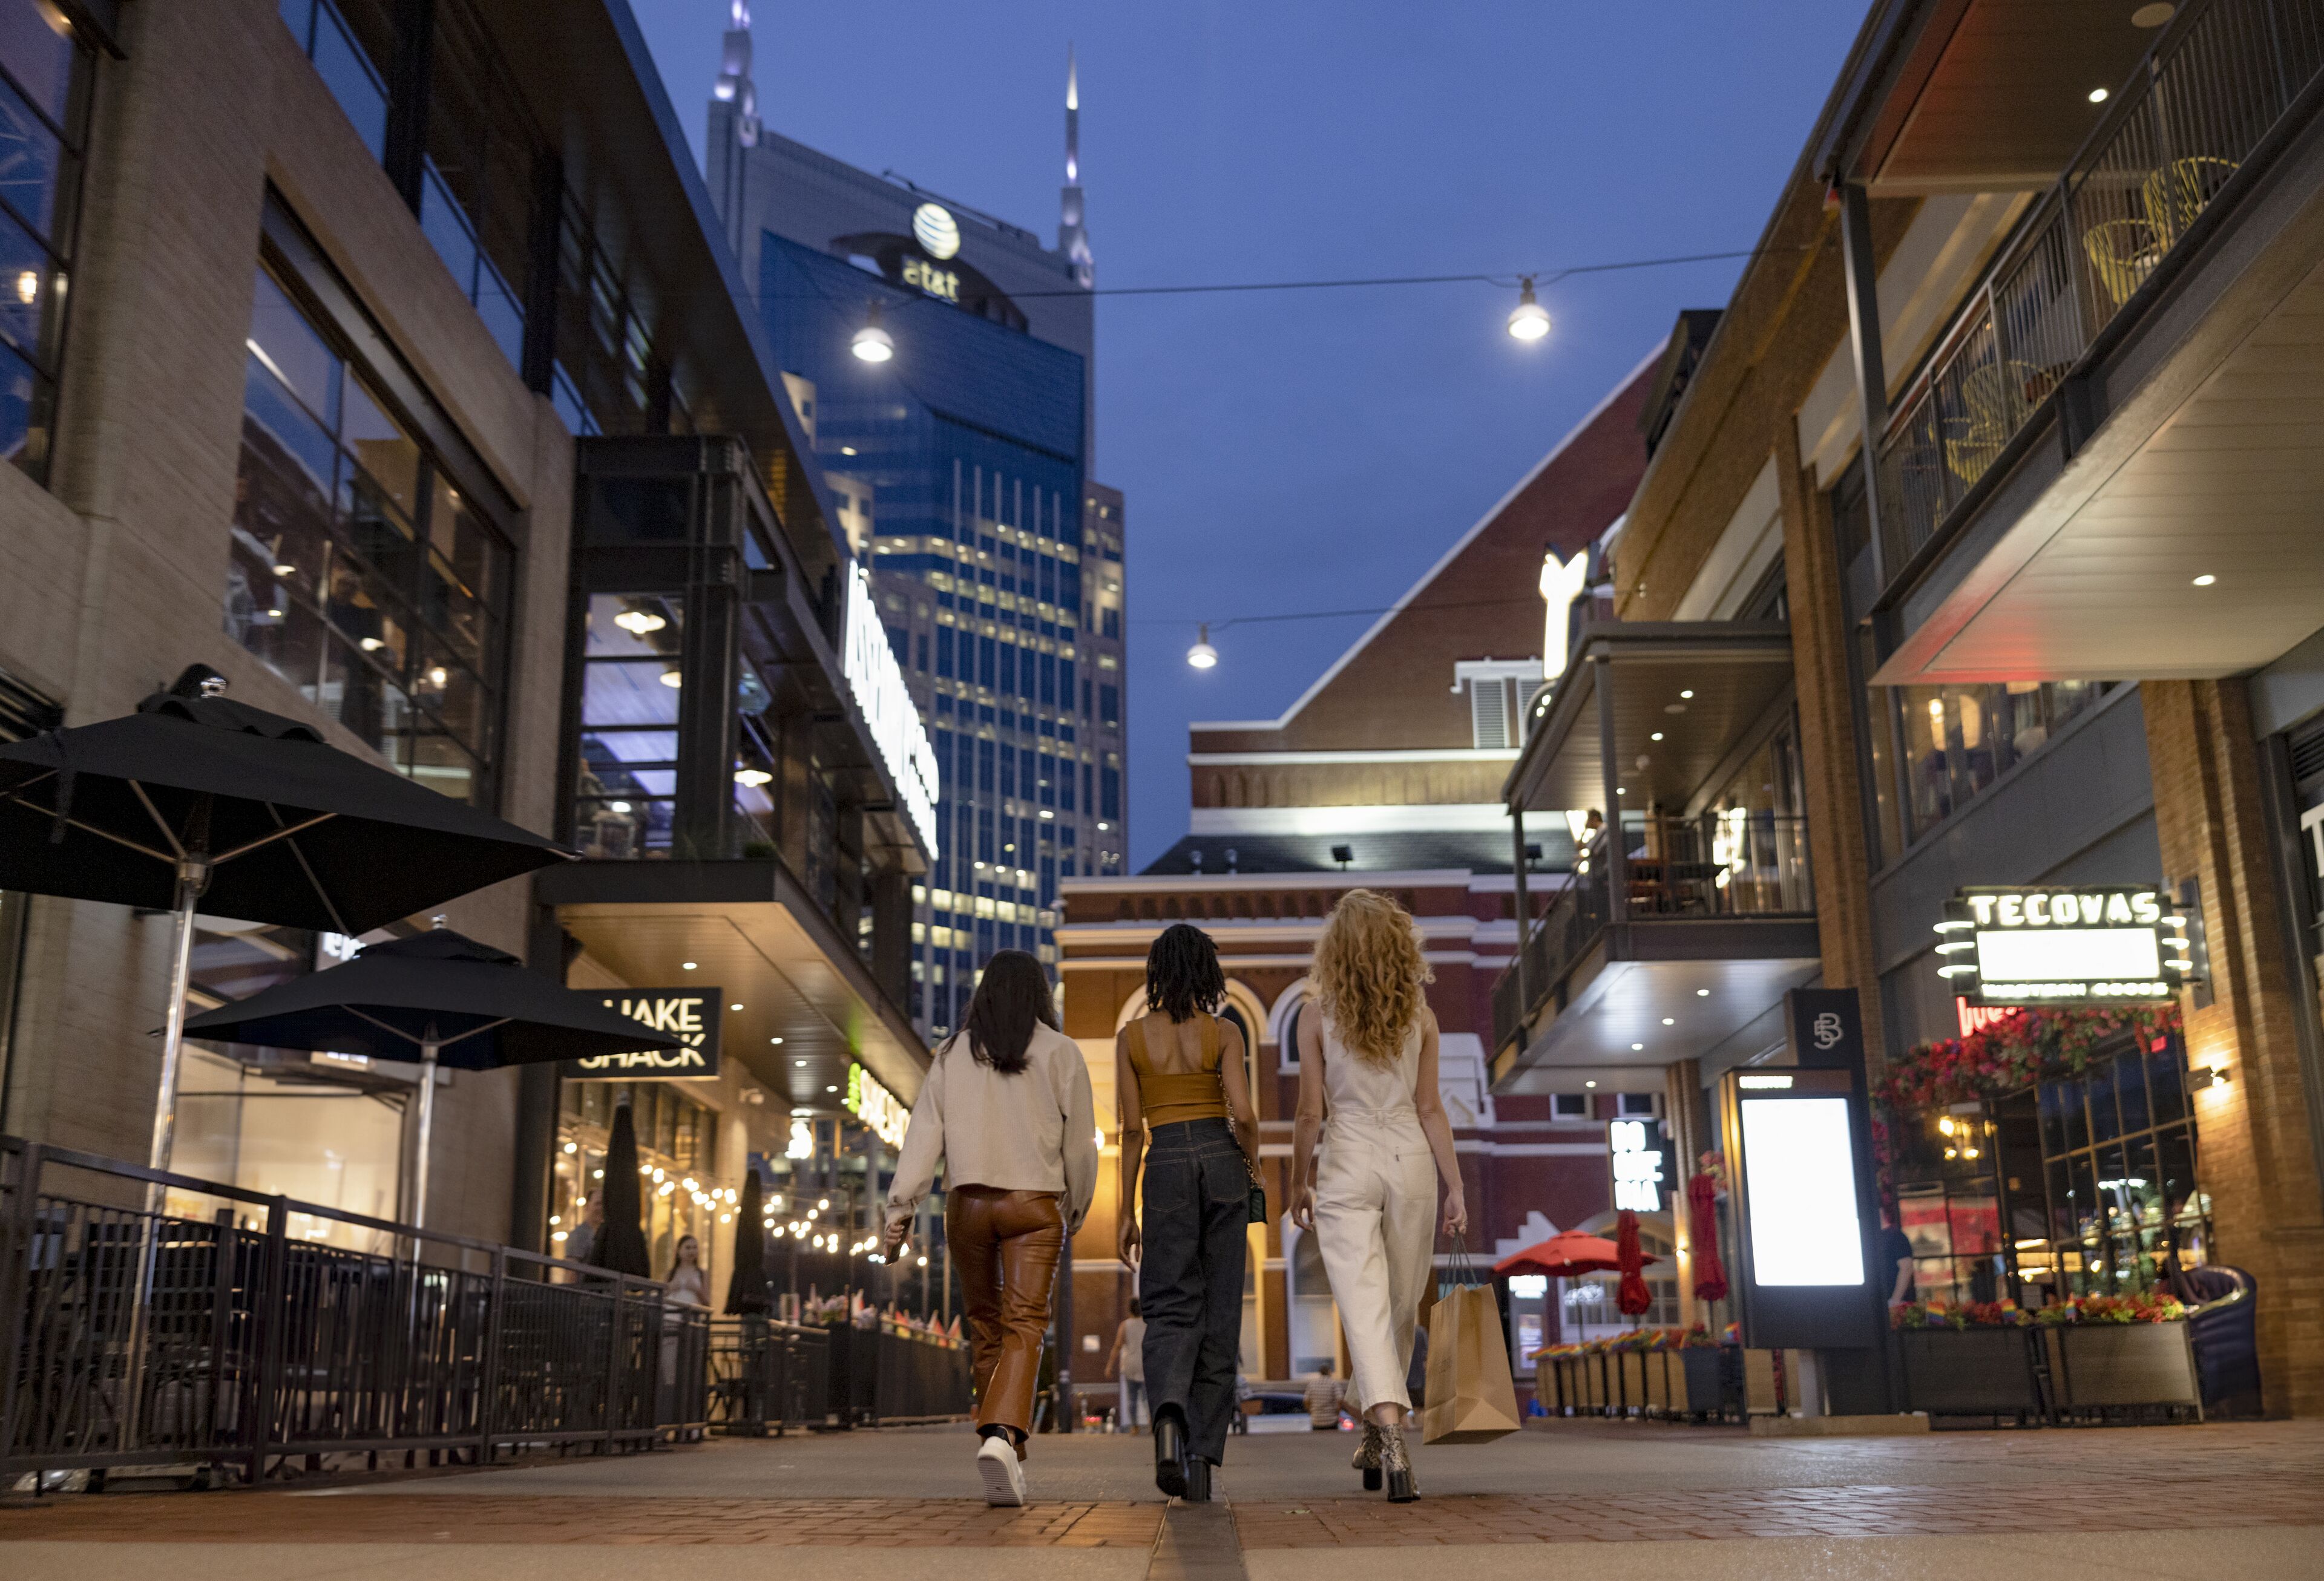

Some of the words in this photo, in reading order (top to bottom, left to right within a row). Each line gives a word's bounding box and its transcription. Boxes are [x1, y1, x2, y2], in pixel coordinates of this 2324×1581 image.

[902, 260, 959, 303] at&t
[1968, 892, 2160, 926] TECOVAS
[603, 998, 704, 1032] AKE
